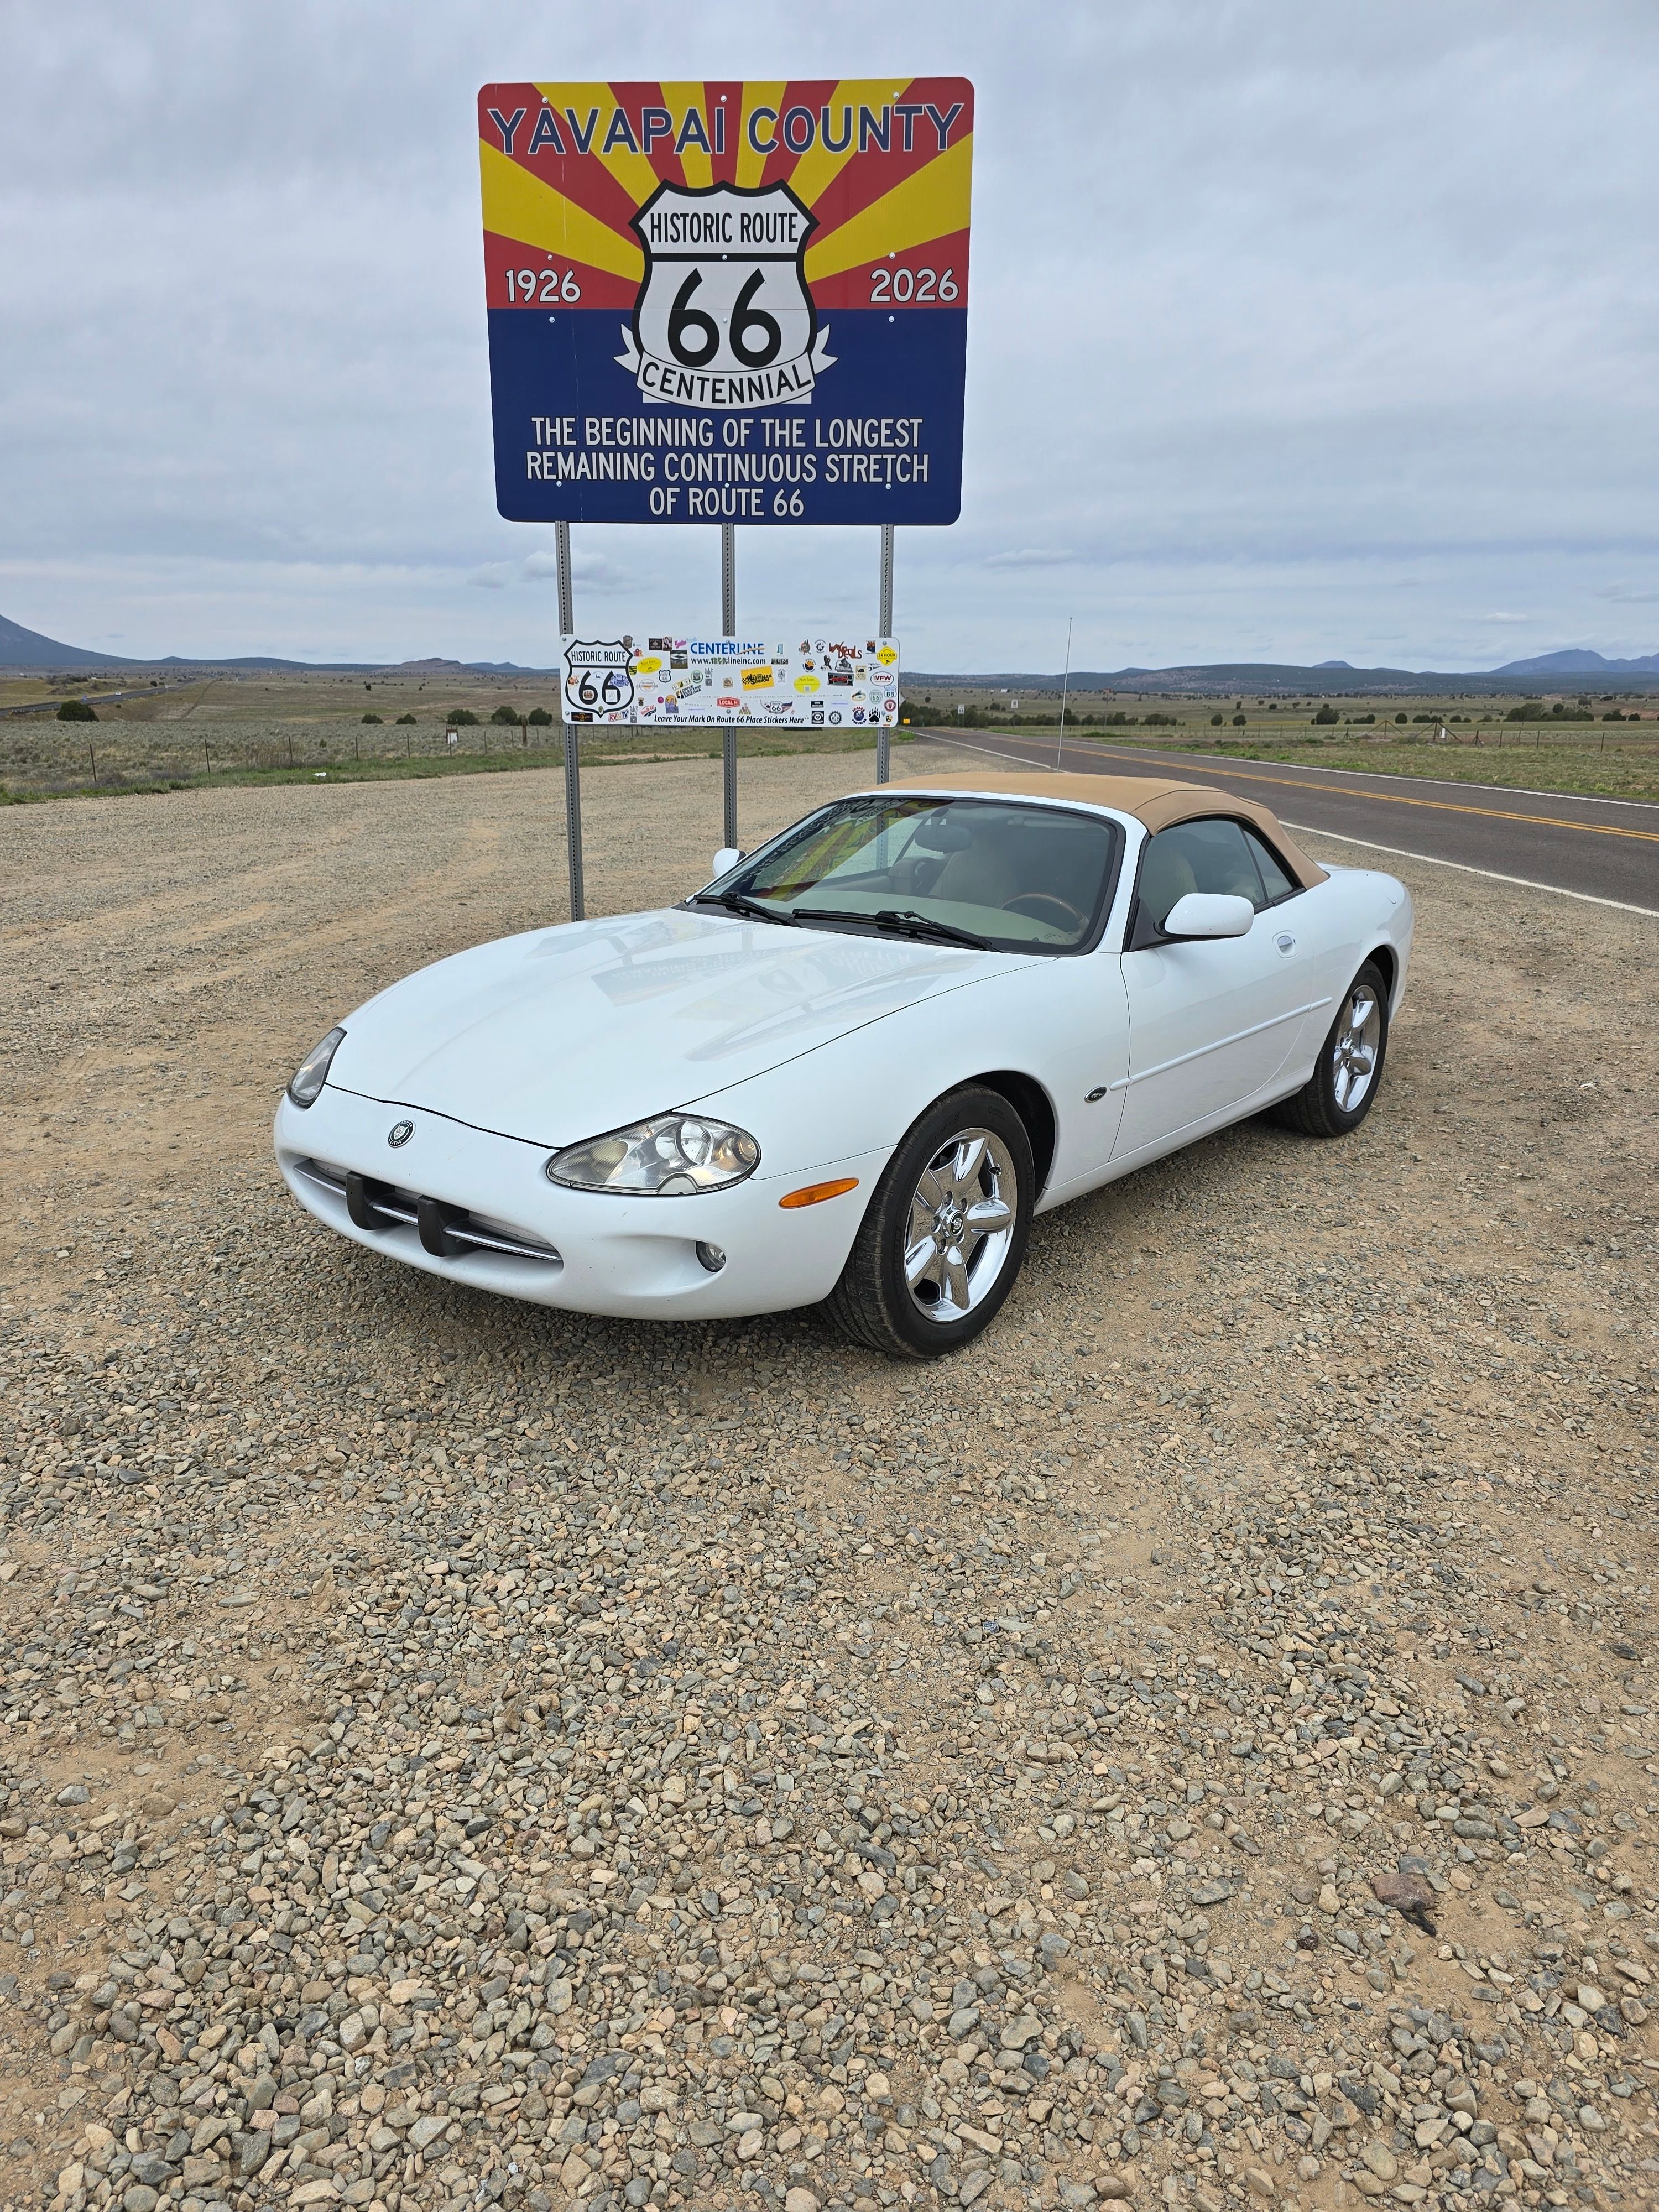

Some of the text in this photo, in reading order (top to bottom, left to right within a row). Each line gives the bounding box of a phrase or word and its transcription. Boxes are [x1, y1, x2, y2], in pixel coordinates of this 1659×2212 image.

[487, 103, 964, 154] YAVAPAI COUNTY
[650, 212, 798, 243] HISTORIC ROUTE
[505, 268, 582, 304] 1926
[869, 267, 959, 303] 2026
[667, 268, 781, 368] 66
[642, 362, 811, 404] CENTENNIAL
[531, 417, 923, 447] THE BEGINNING OF THE LONGEST
[526, 452, 928, 482] REMAINING CONTINUOUS STRETCH
[650, 487, 804, 517] OF ROUTE 66
[571, 651, 626, 662] HISTORIC ROUTE
[691, 643, 764, 655] CENTERLINE
[579, 670, 621, 705] 66
